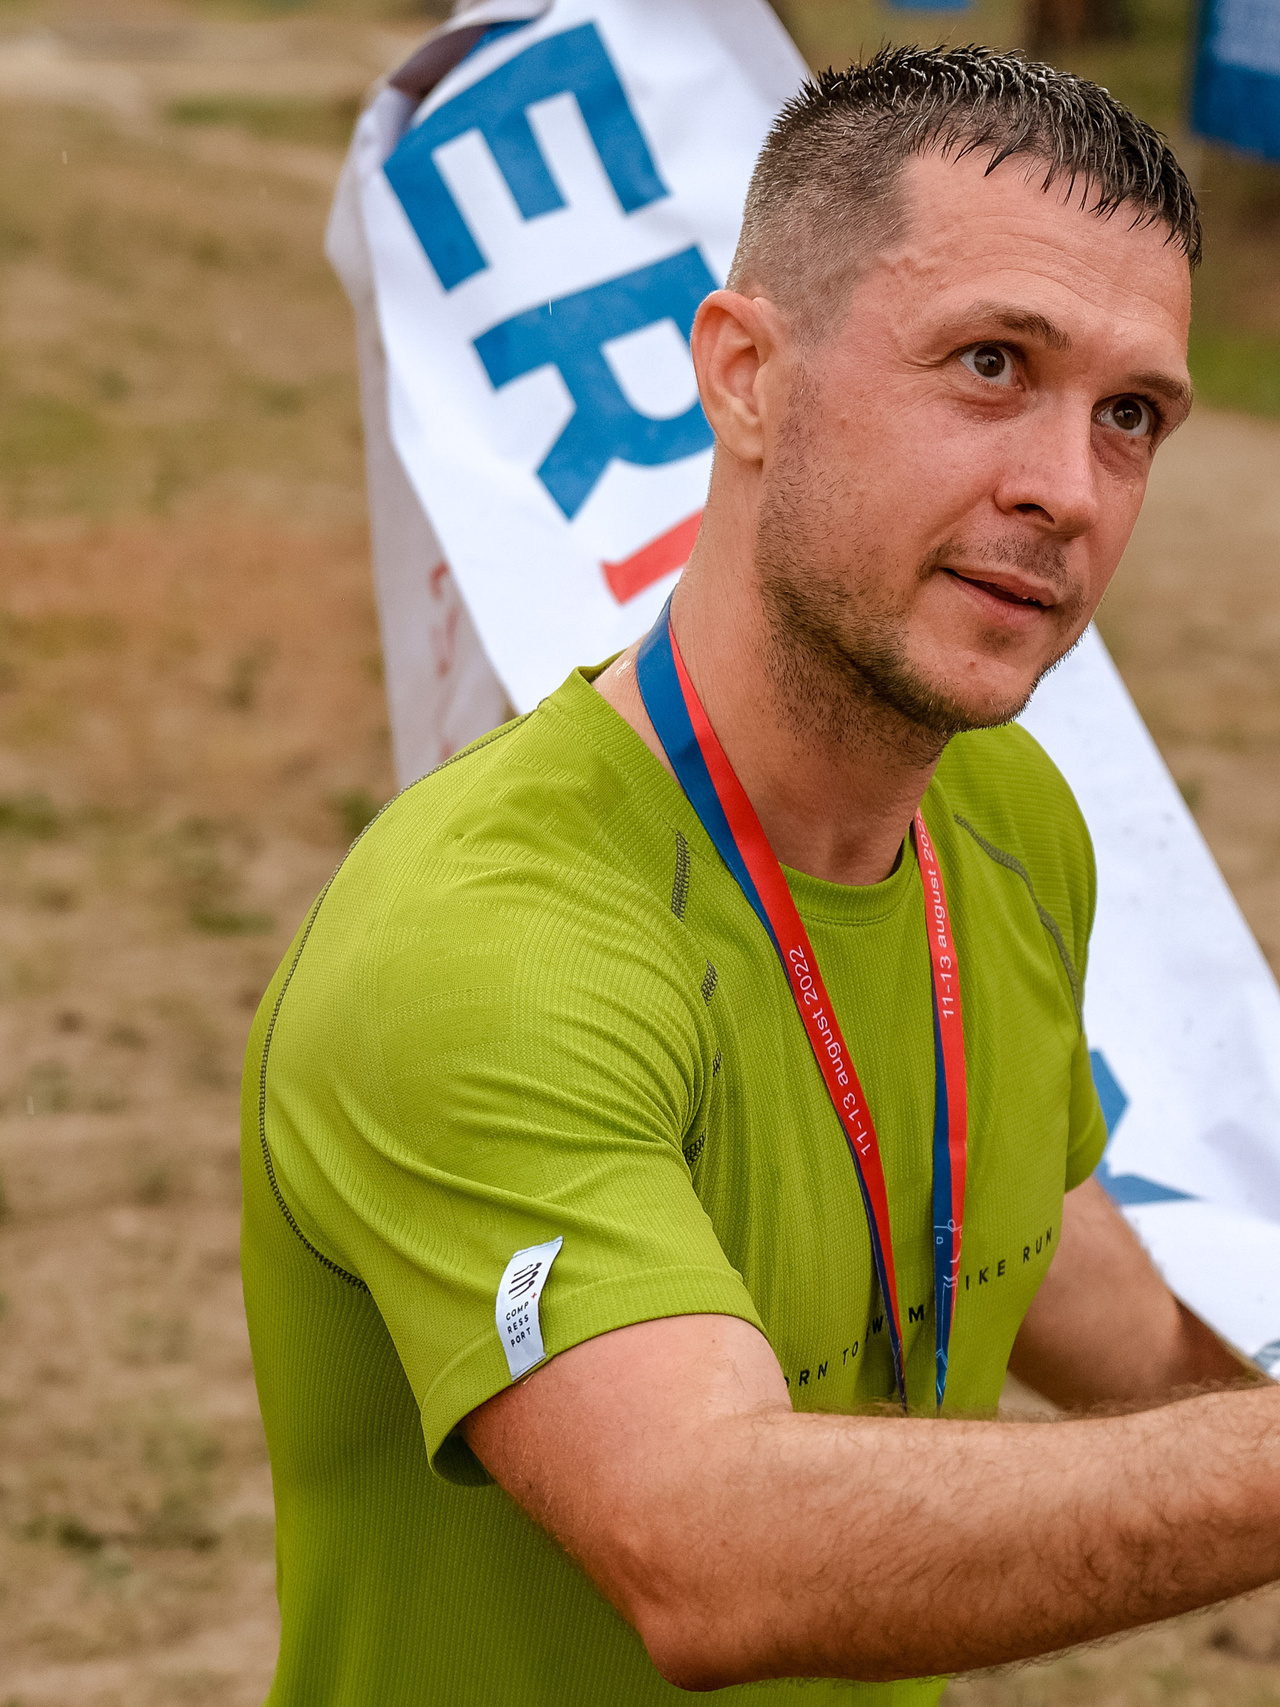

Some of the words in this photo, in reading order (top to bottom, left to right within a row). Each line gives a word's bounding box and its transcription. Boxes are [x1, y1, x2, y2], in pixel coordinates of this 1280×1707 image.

[927, 869, 948, 948] august
[789, 945, 818, 1005] 2022
[938, 955, 955, 1018] 11-13
[812, 1008, 849, 1086] august
[843, 1093, 871, 1155] 11-13
[505, 1301, 529, 1321] COMP
[507, 1313, 529, 1334] RESS
[842, 1340, 860, 1366] TO
[1022, 1227, 1053, 1264] RUN
[511, 1326, 532, 1348] PORT
